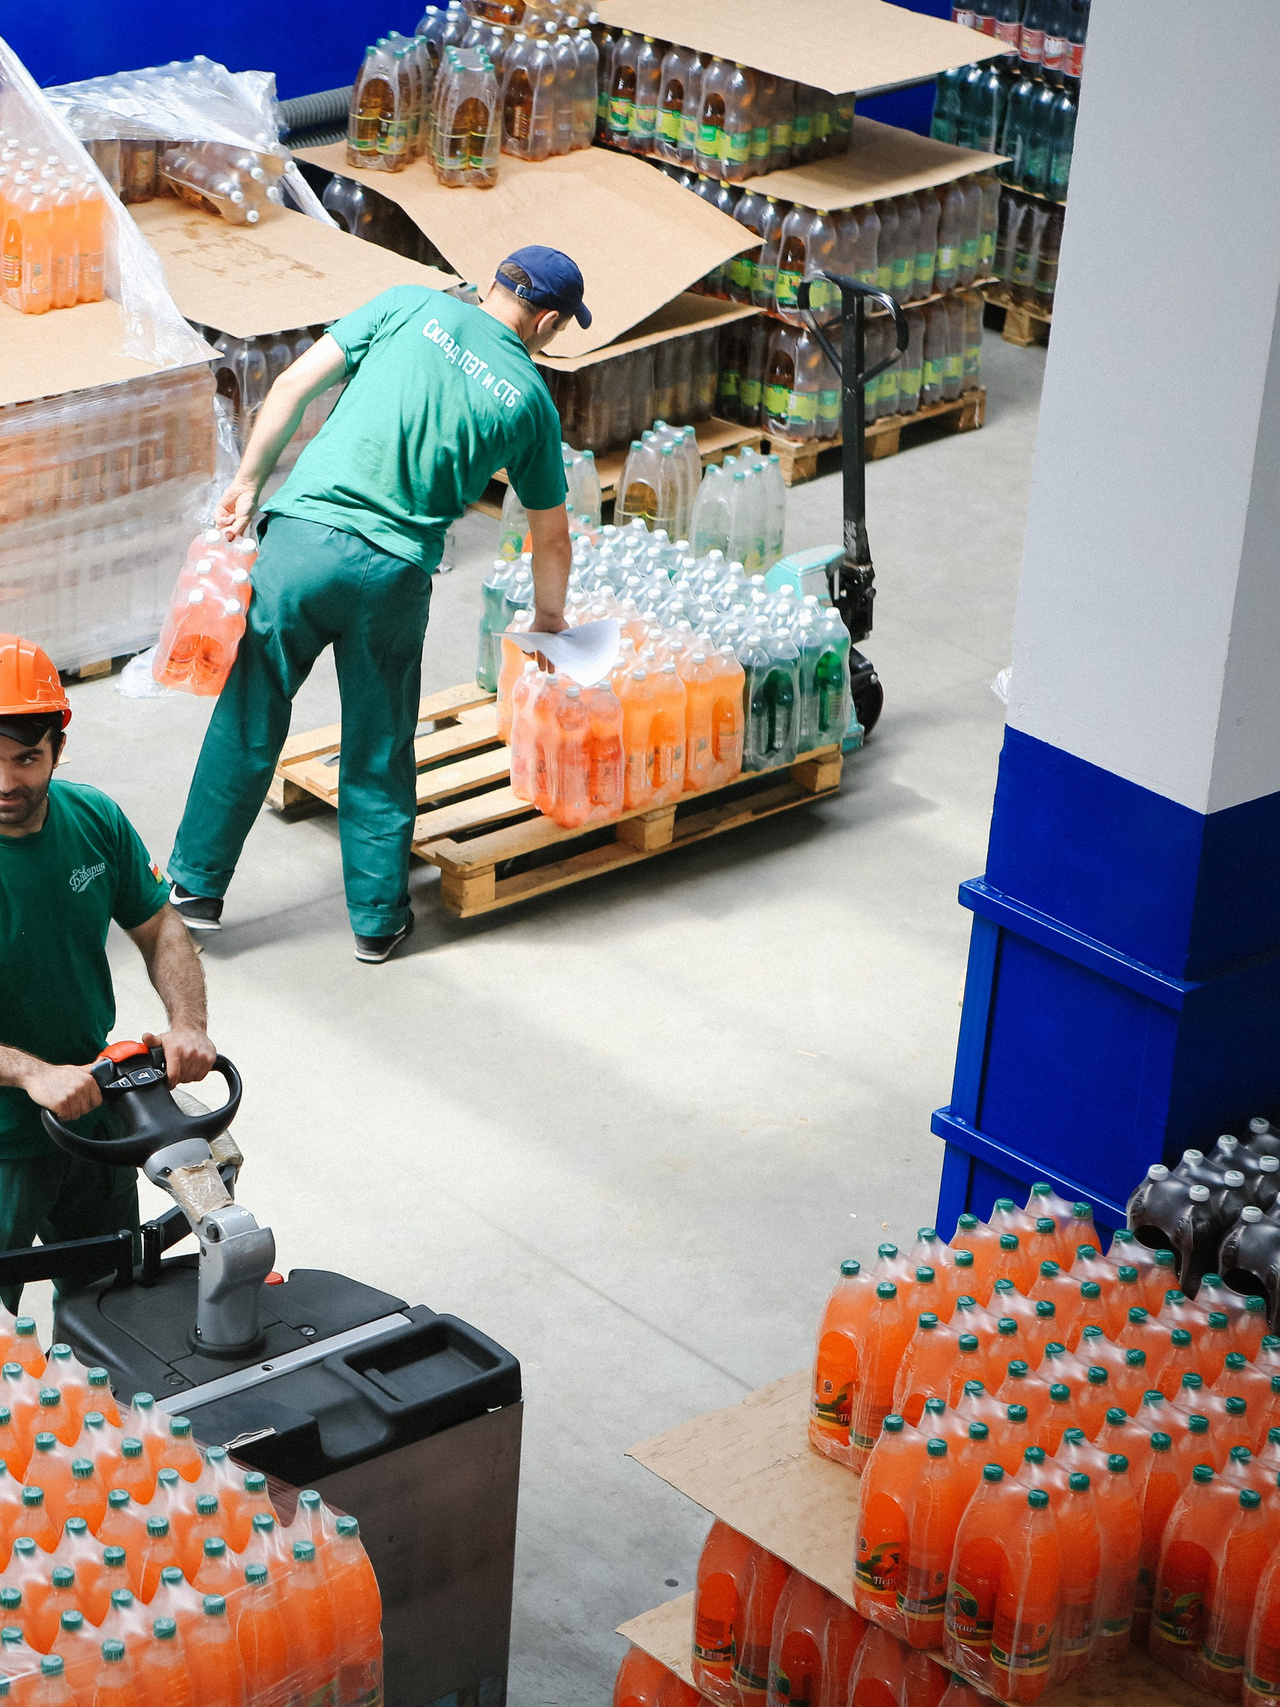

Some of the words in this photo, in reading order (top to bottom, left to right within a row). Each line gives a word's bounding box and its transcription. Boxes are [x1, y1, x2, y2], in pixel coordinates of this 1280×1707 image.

[422, 318, 460, 364] Склад
[457, 349, 488, 380] ПЭТ
[481, 370, 496, 390] и
[493, 378, 522, 408] СТБ
[68, 862, 106, 892] Бавария
